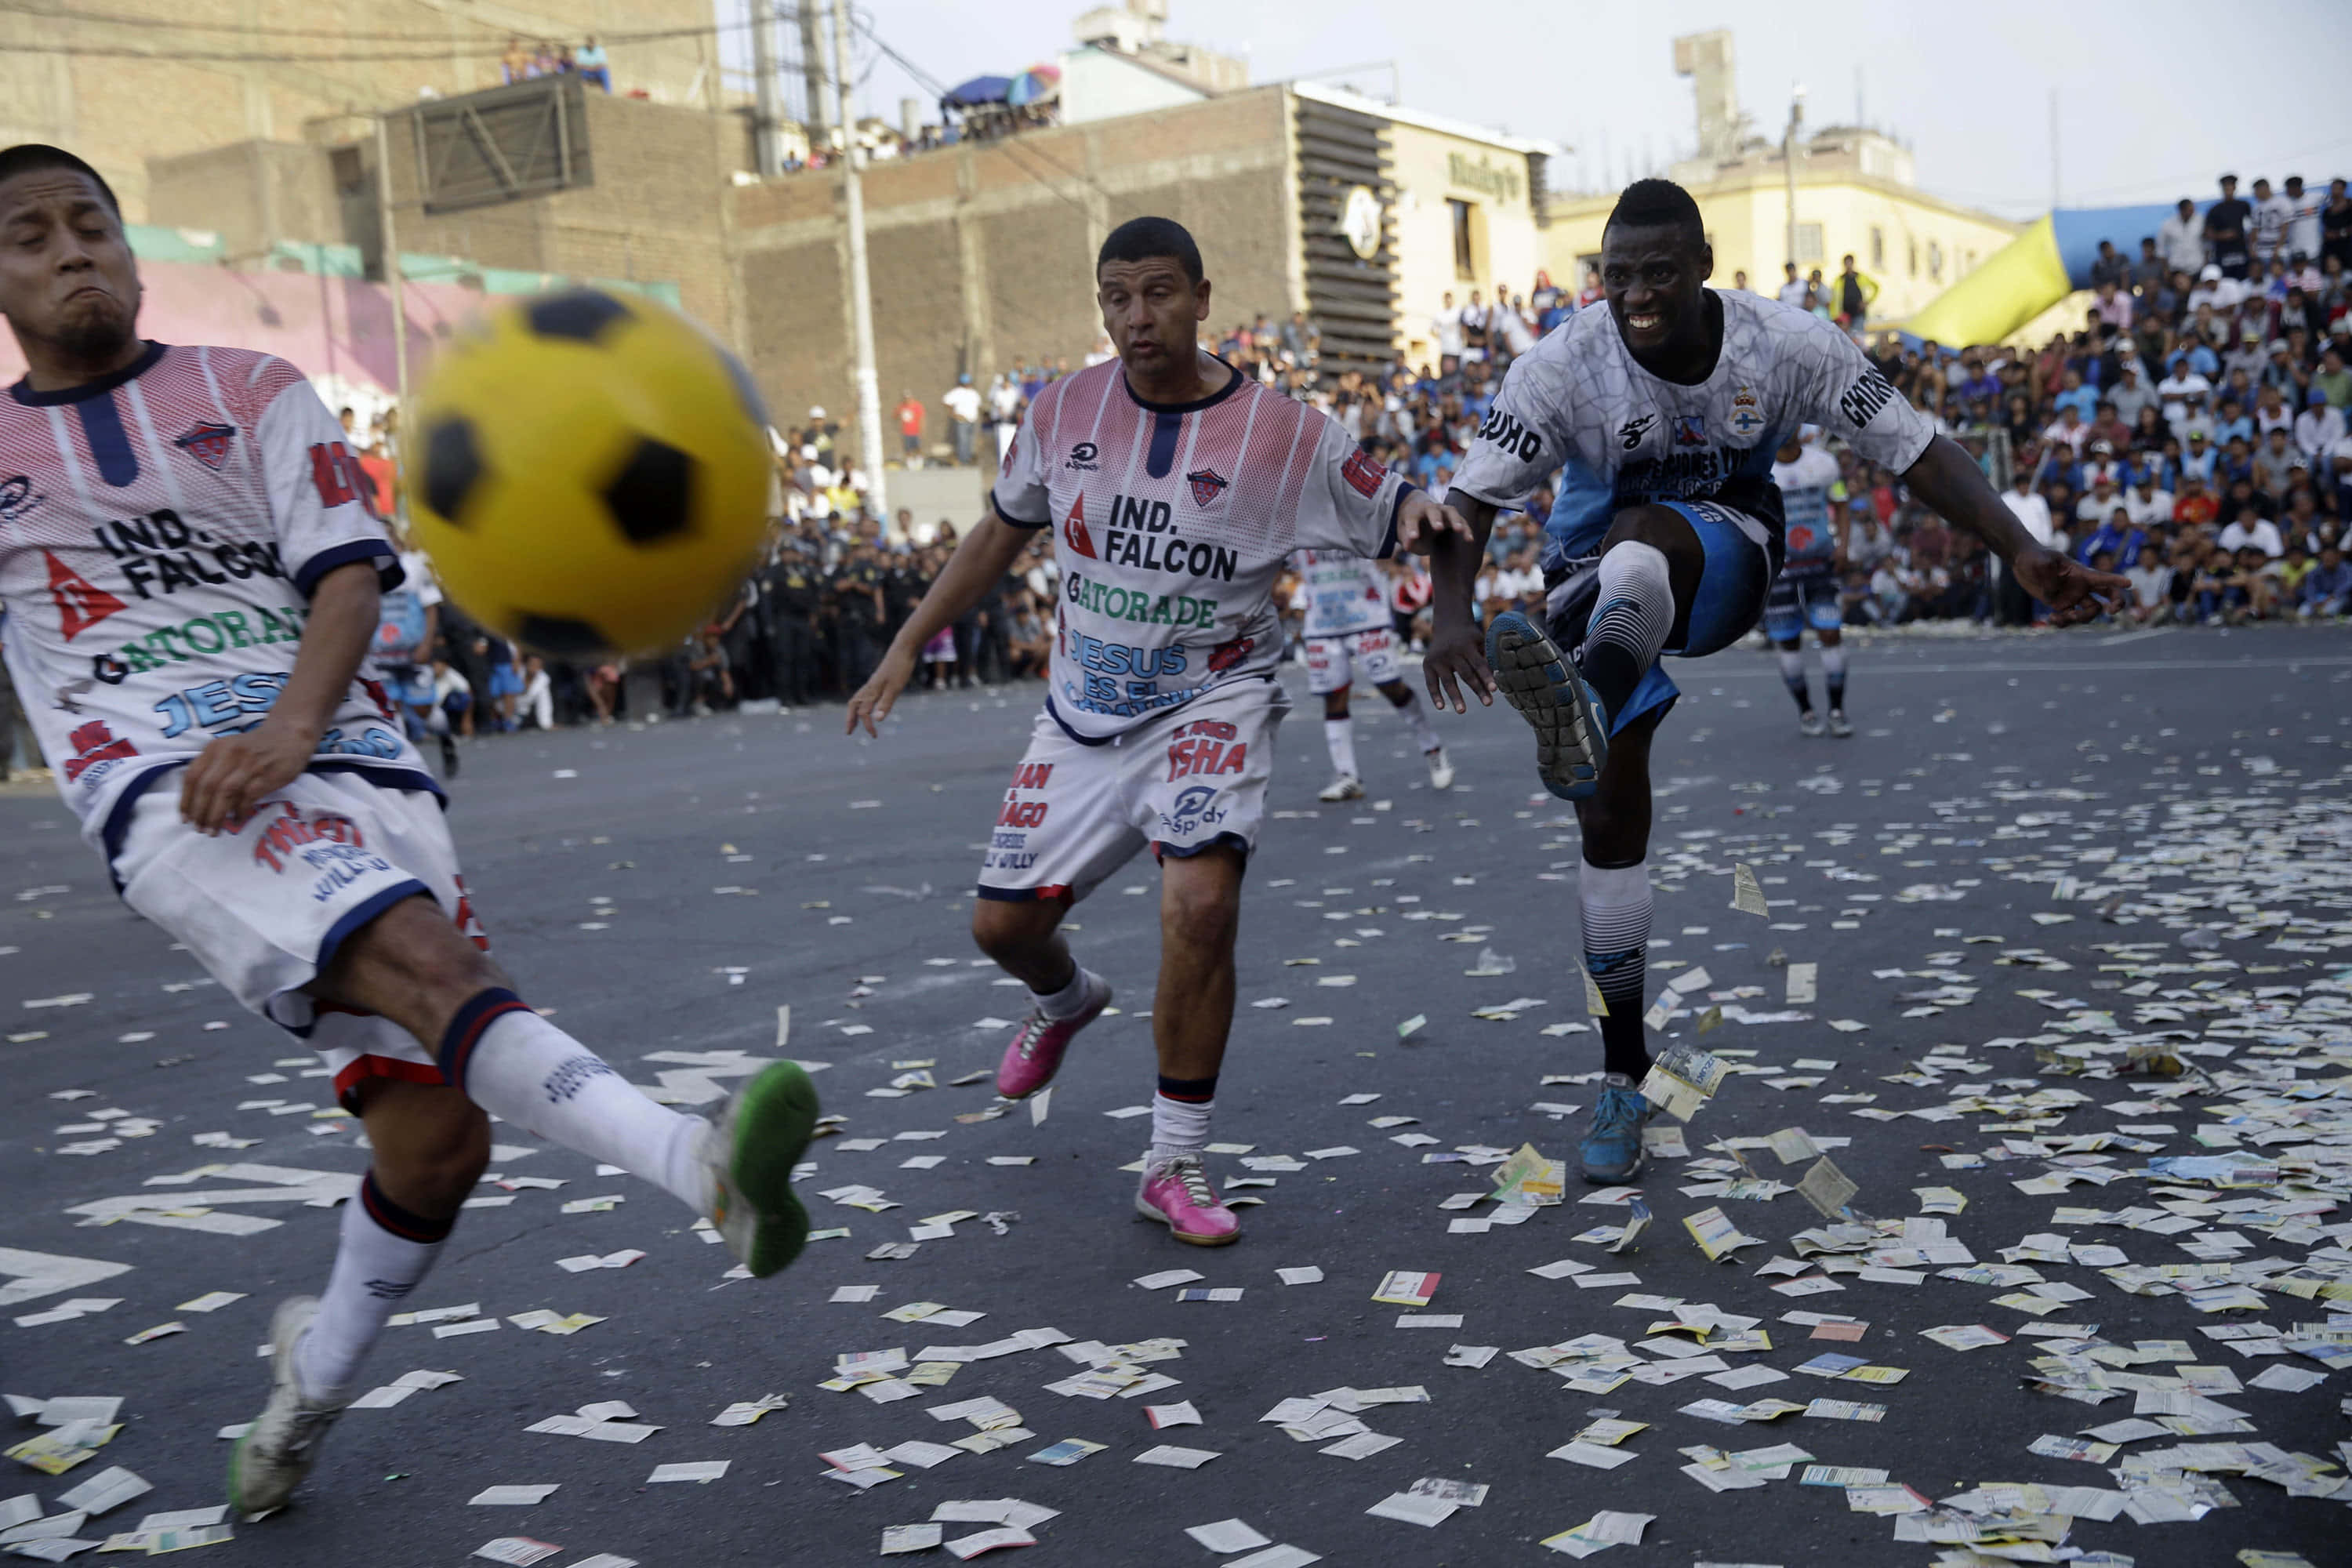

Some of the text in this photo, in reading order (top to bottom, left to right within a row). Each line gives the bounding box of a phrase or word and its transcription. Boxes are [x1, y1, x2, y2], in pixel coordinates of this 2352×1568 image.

[93, 507, 213, 560] IND.
[1069, 517, 1081, 548] F
[1109, 495, 1178, 535] IND.
[1105, 531, 1238, 583] FALCON
[1067, 571, 1218, 630] GATORADE
[1069, 629, 1187, 679] JESUS
[153, 672, 290, 739] JES
[1084, 670, 1117, 702] ES
[1190, 720, 1237, 742] AMIGO
